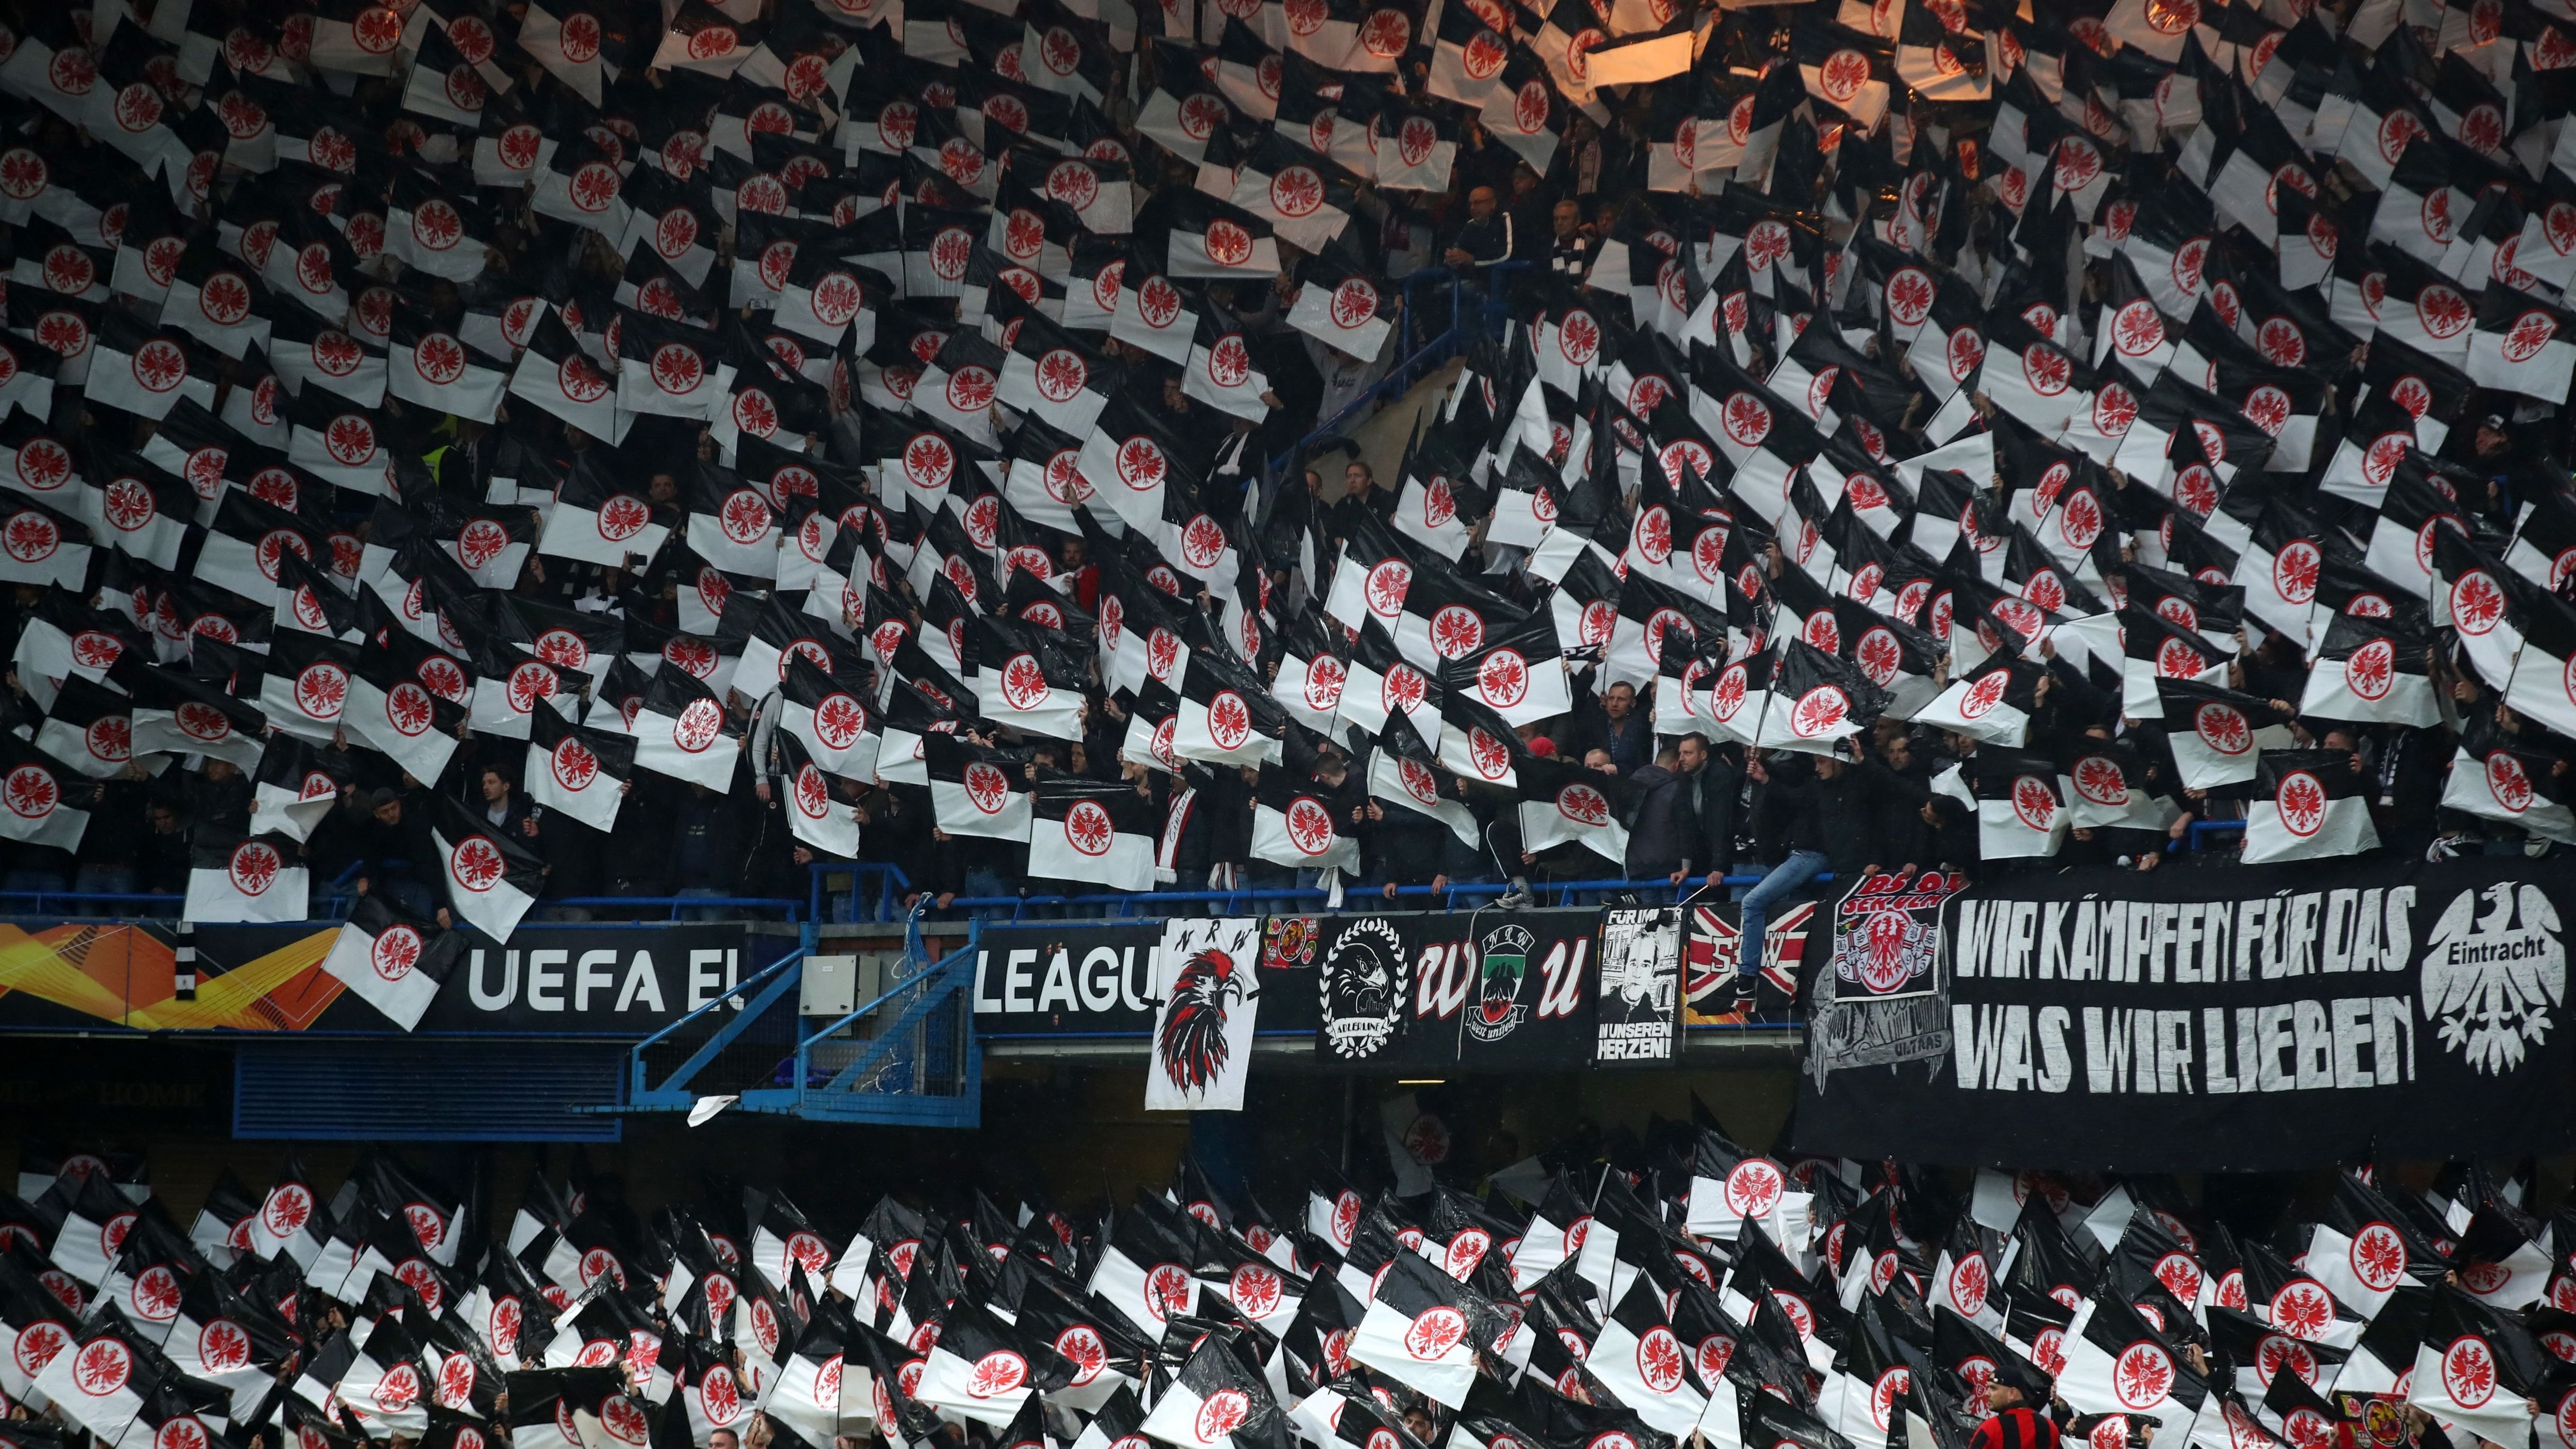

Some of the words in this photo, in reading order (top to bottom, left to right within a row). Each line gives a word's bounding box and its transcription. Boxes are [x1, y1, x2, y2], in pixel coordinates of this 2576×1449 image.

[1855, 872, 1912, 896] BS
[1608, 910, 1637, 924] FÜR
[1637, 908, 1683, 924] IMR
[1957, 899, 2038, 979] WIR
[2039, 893, 2233, 983] KÄMPFEN
[2235, 889, 2322, 981] FÜR
[2323, 885, 2416, 973] DAS
[1710, 931, 1787, 973] SW
[2448, 935, 2546, 965] Eintracht
[469, 949, 666, 1012] UEFA
[1337, 1022, 1380, 1033] ADLERLINE
[1487, 1016, 1514, 1039] united
[1609, 1021, 1673, 1038] UNSEREN
[1598, 1037, 1672, 1060] HERZEN!
[1895, 1034, 1942, 1056] ULTRAS
[1953, 1003, 2072, 1093] WAS
[2083, 1006, 2194, 1094] WIR
[2204, 995, 2415, 1094] LIEBEN
